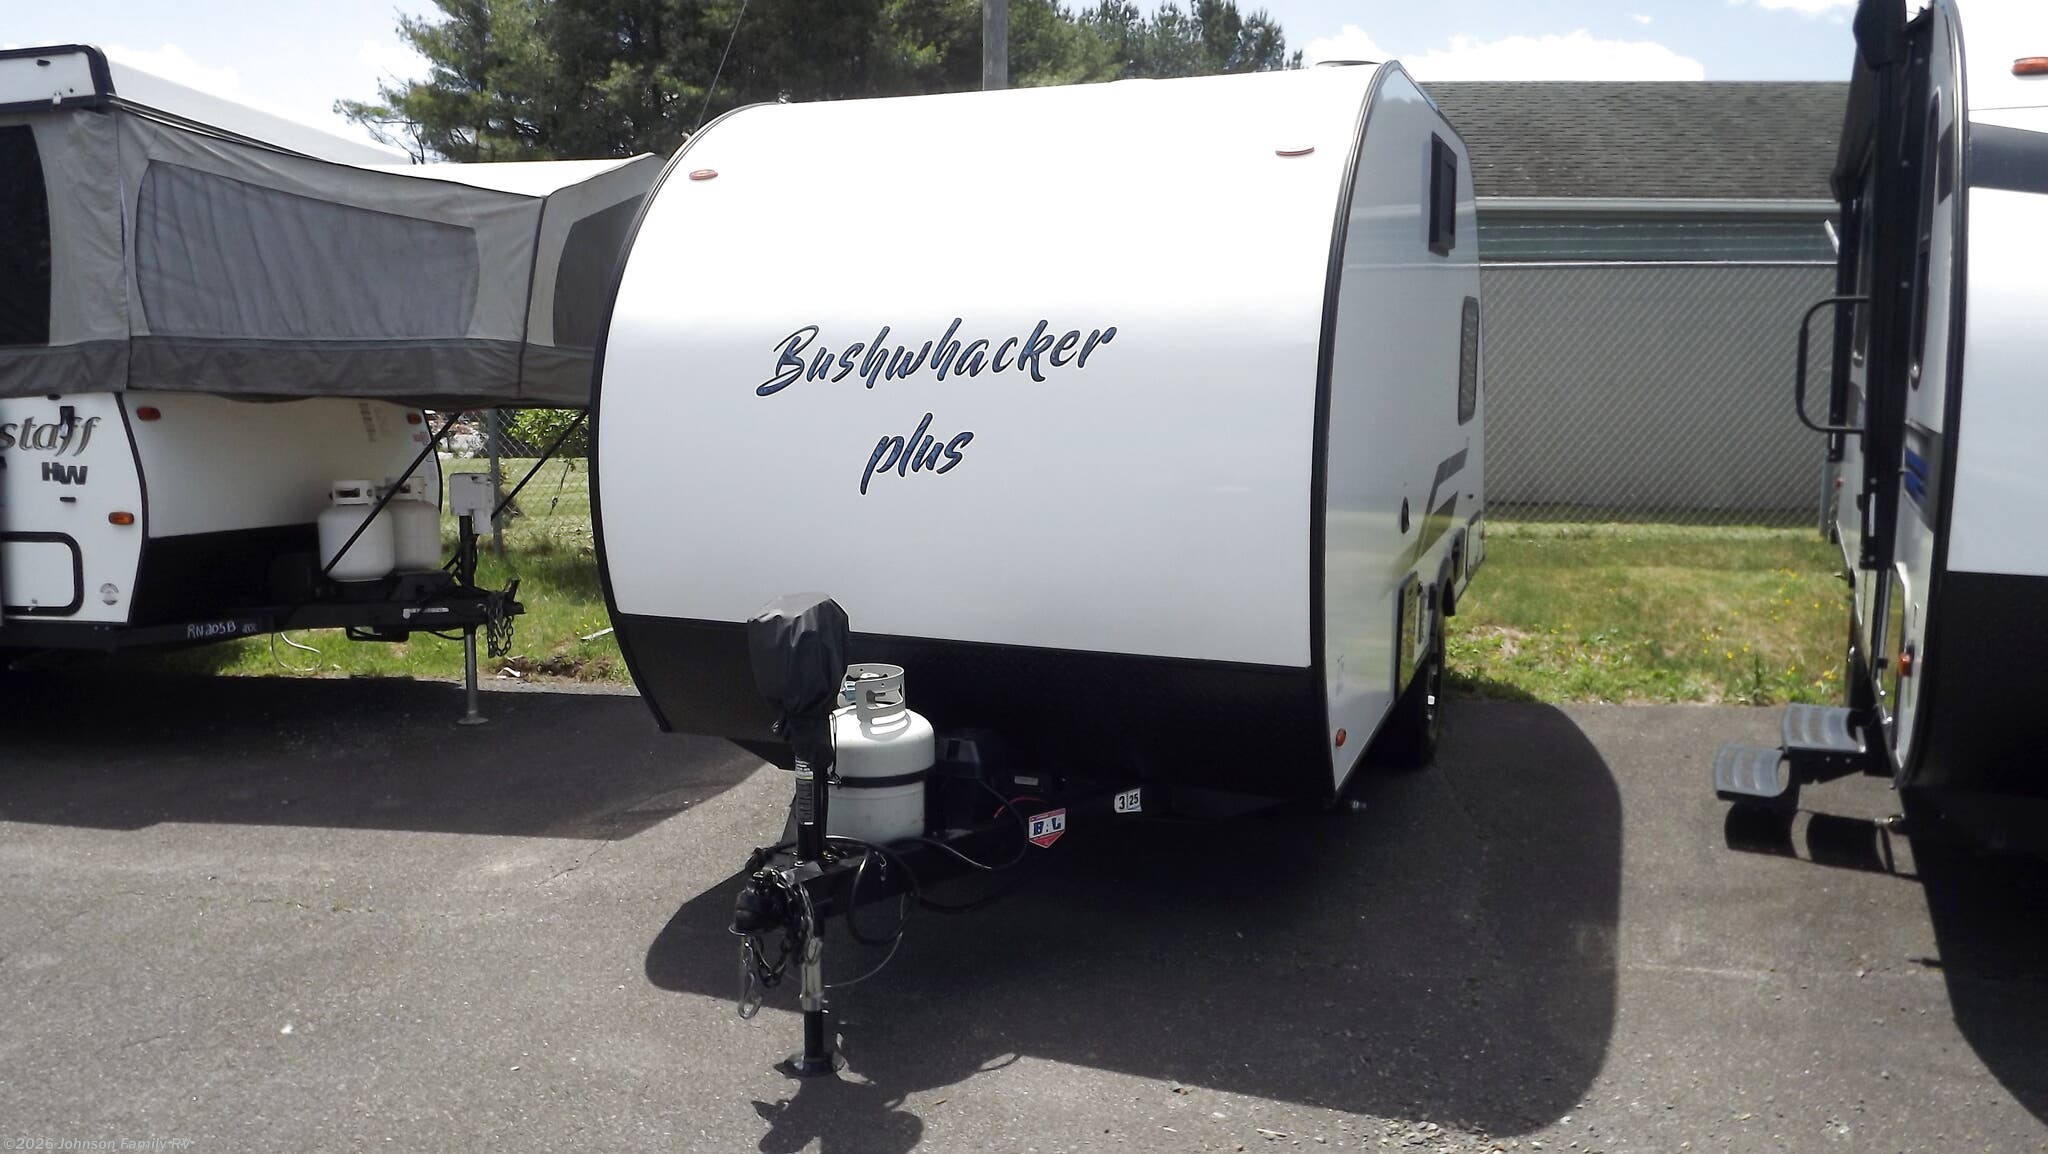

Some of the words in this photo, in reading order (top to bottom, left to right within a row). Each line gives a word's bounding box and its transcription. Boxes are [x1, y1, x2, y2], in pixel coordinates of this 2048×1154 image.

[755, 318, 1118, 396] Bushwhacker
[41, 462, 88, 485] HW
[860, 412, 974, 496] plus
[1118, 795, 1126, 810] 3
[1129, 793, 1139, 806] 25
